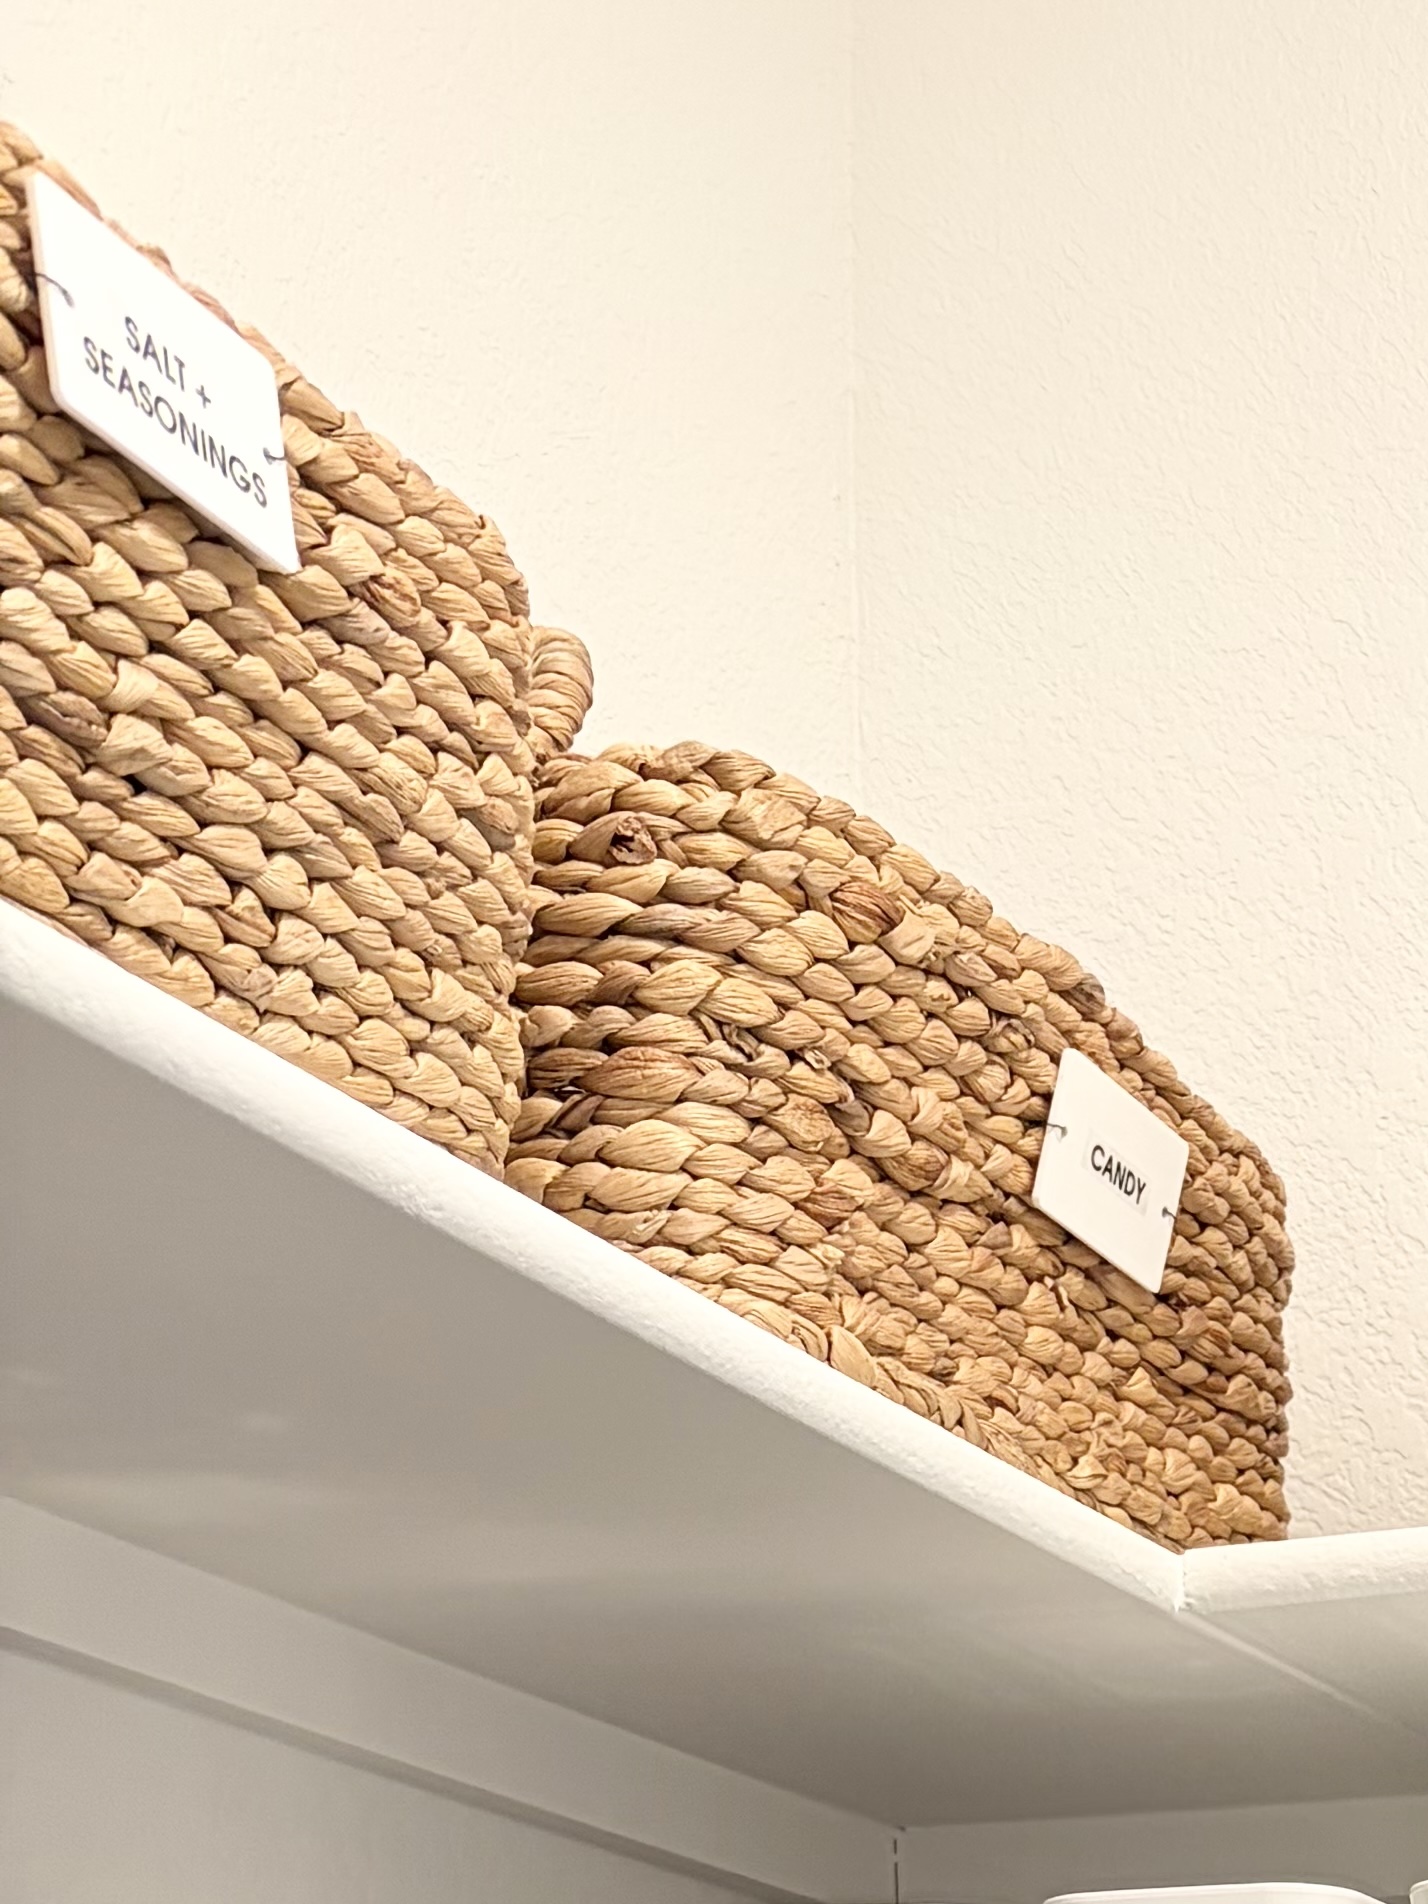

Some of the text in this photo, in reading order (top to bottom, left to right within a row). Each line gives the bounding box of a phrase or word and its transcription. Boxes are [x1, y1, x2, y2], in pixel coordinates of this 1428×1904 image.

[124, 315, 211, 408] SALT +
[83, 335, 268, 509] SEASONINGS
[1090, 1145, 1147, 1205] CANDY
